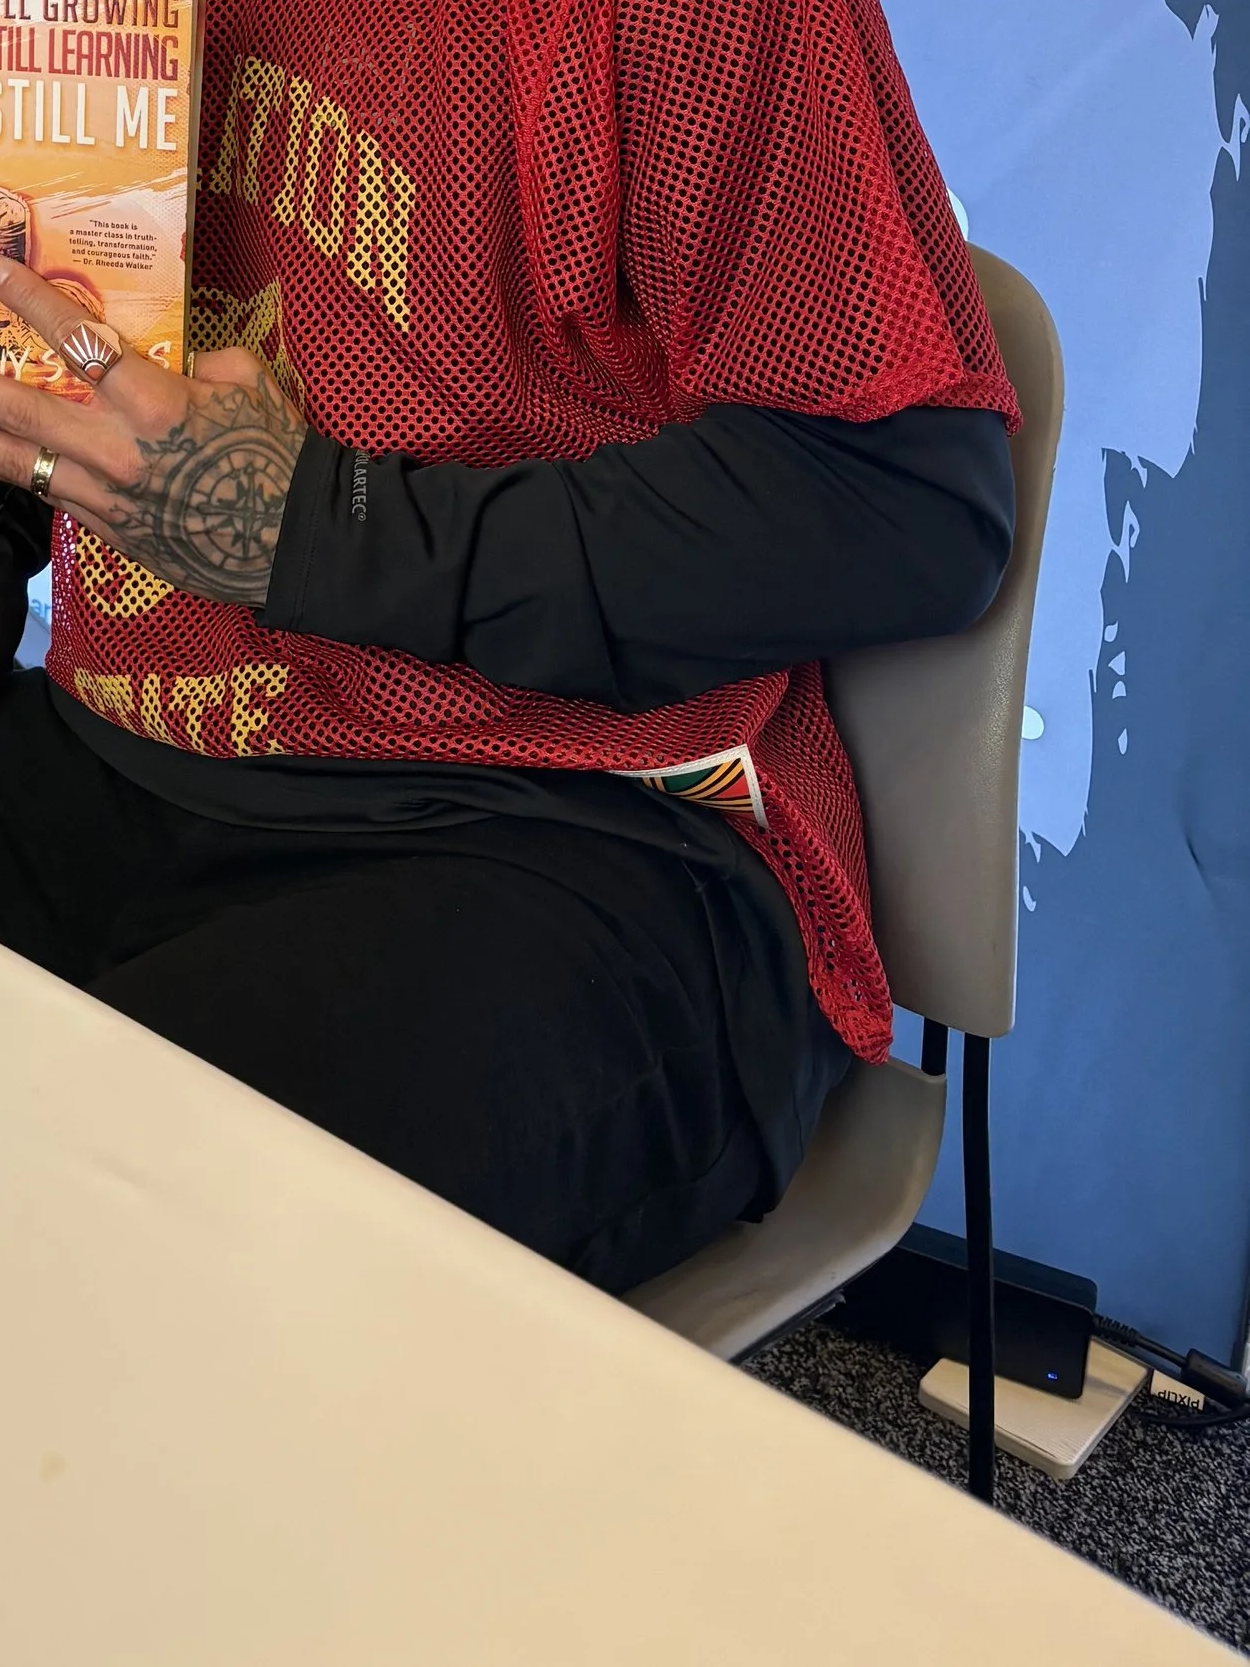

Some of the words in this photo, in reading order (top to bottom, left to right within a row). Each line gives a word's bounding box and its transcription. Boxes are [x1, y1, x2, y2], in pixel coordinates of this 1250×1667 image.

[48, 28, 179, 81] LEARNING
[115, 85, 178, 151] ME
[110, 222, 129, 230] book
[131, 223, 138, 231] is
[75, 229, 102, 238] master
[104, 231, 124, 239] class
[134, 234, 157, 242] truth-
[69, 238, 96, 248] telling,
[97, 240, 158, 252] transformation,
[87, 249, 130, 259] courageous
[83, 258, 94, 266] Dr.
[125, 261, 153, 271] Walker
